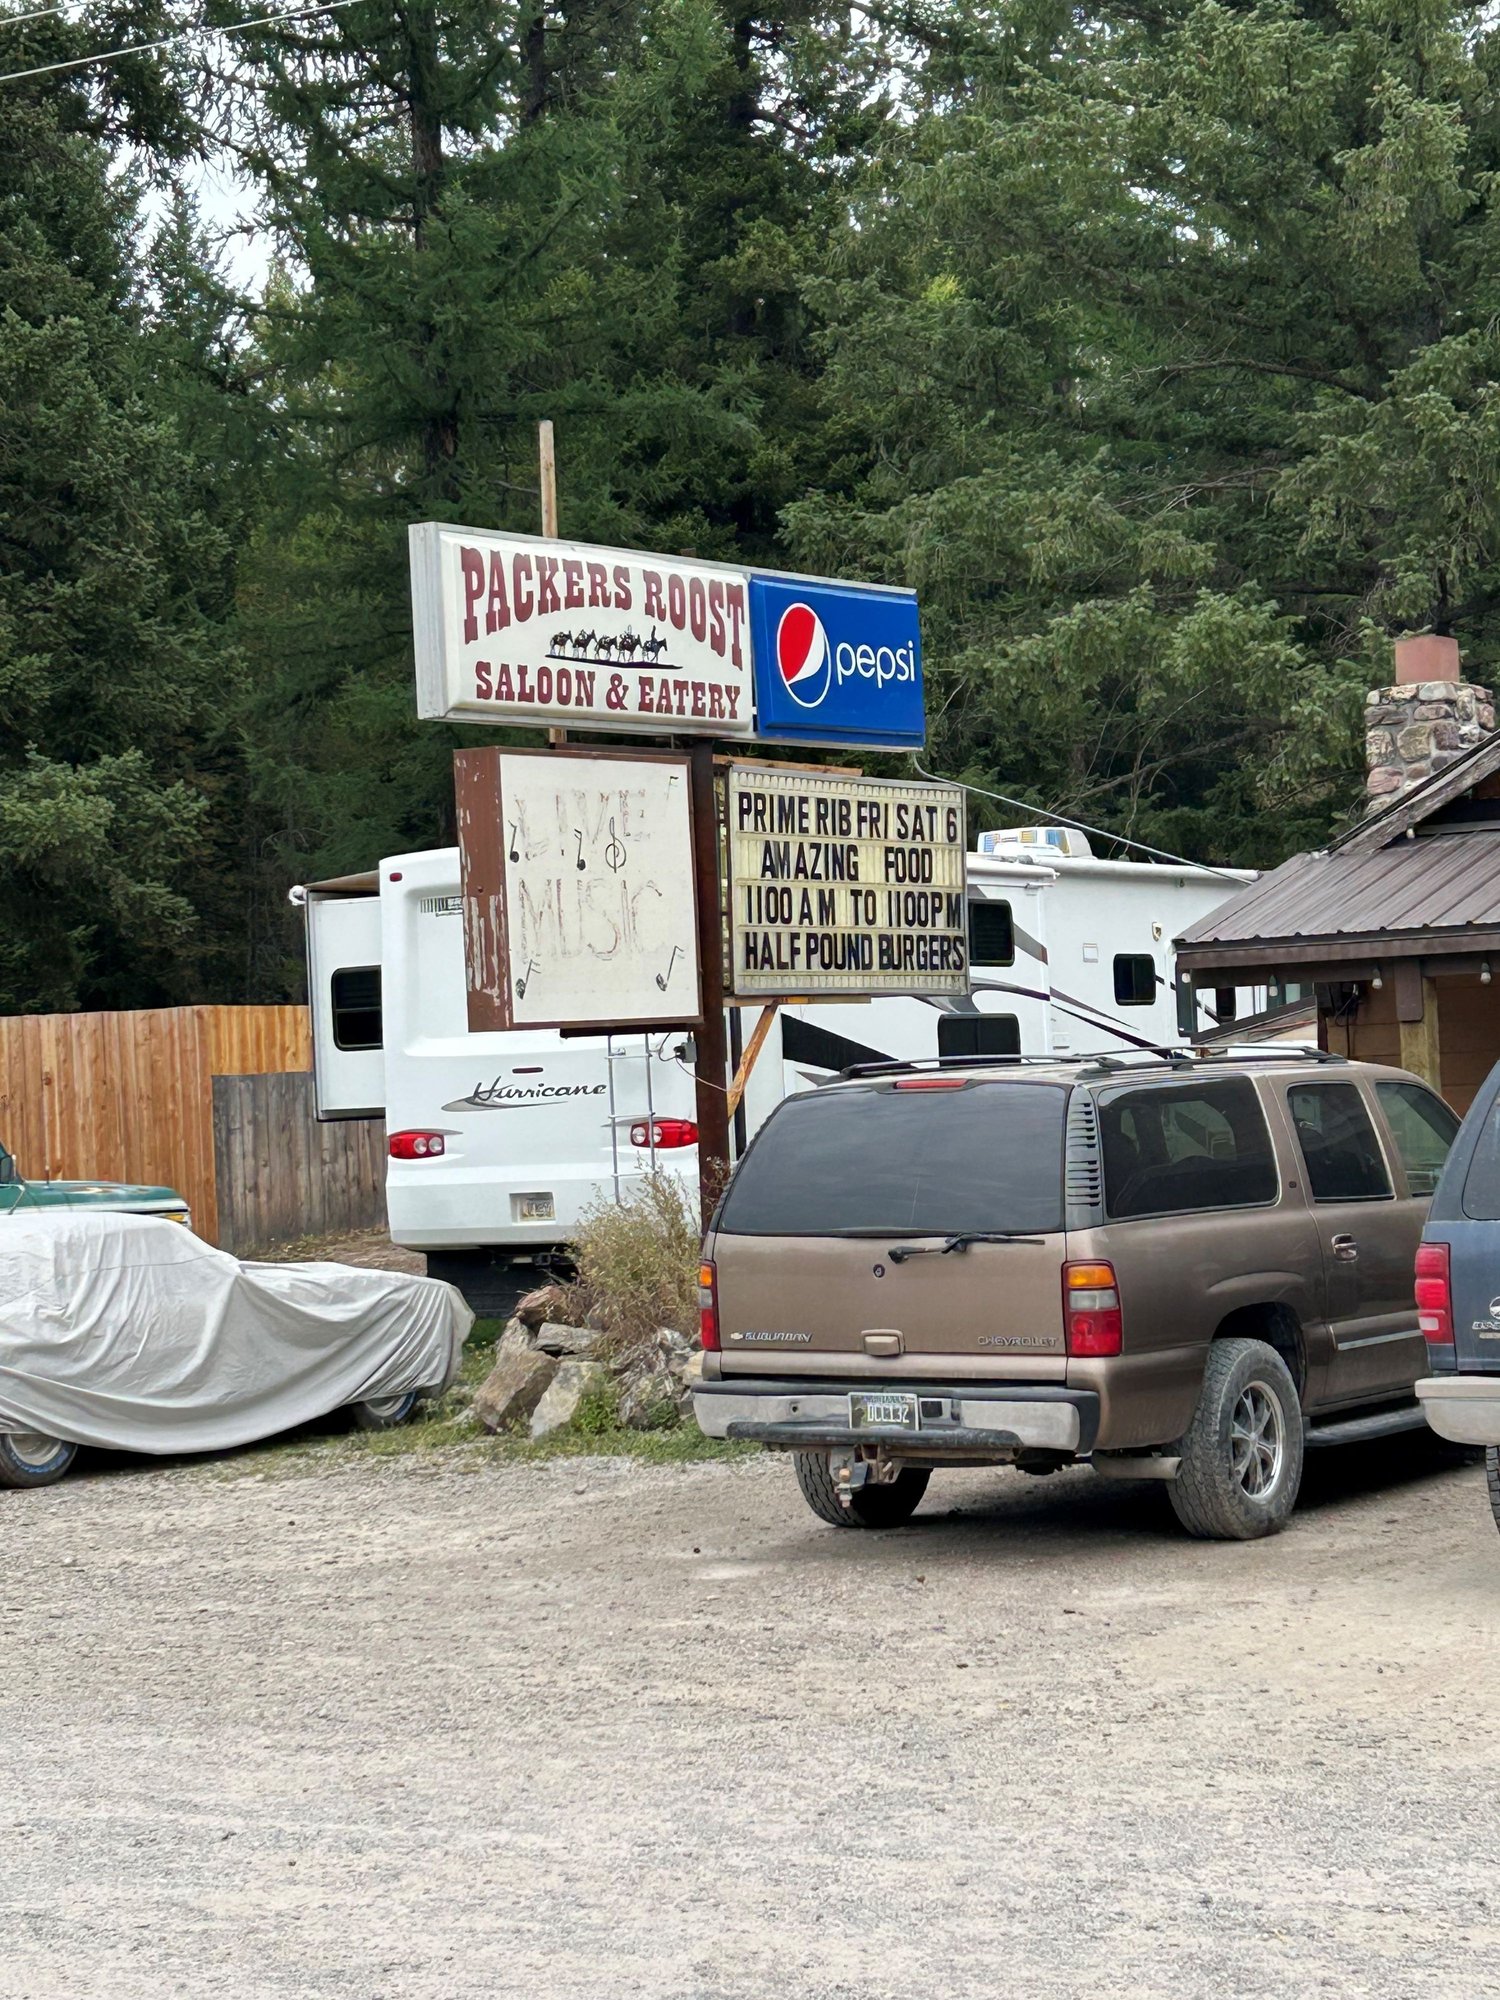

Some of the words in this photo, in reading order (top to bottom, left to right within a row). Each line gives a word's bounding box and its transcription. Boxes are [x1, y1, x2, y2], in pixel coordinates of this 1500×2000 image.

[460, 545, 632, 645] PACKERS
[642, 568, 745, 671] ROOST
[836, 640, 915, 688] pepsi
[475, 660, 596, 707] SALOON
[606, 672, 630, 710] &
[638, 676, 741, 720] EATERY
[738, 791, 809, 834] PRIME
[817, 797, 851, 836] RIB
[857, 800, 889, 840] FRI
[896, 803, 938, 842] SAT
[946, 807, 958, 843] 6
[760, 840, 860, 881] AMAZING
[884, 846, 933, 883] FOOD
[850, 889, 877, 926] TO
[745, 931, 801, 970] HALF
[806, 932, 873, 971] POUND
[878, 934, 965, 972] BURGERS
[472, 1075, 607, 1101] Hurricane
[977, 1335, 1057, 1347] CHEVROLET
